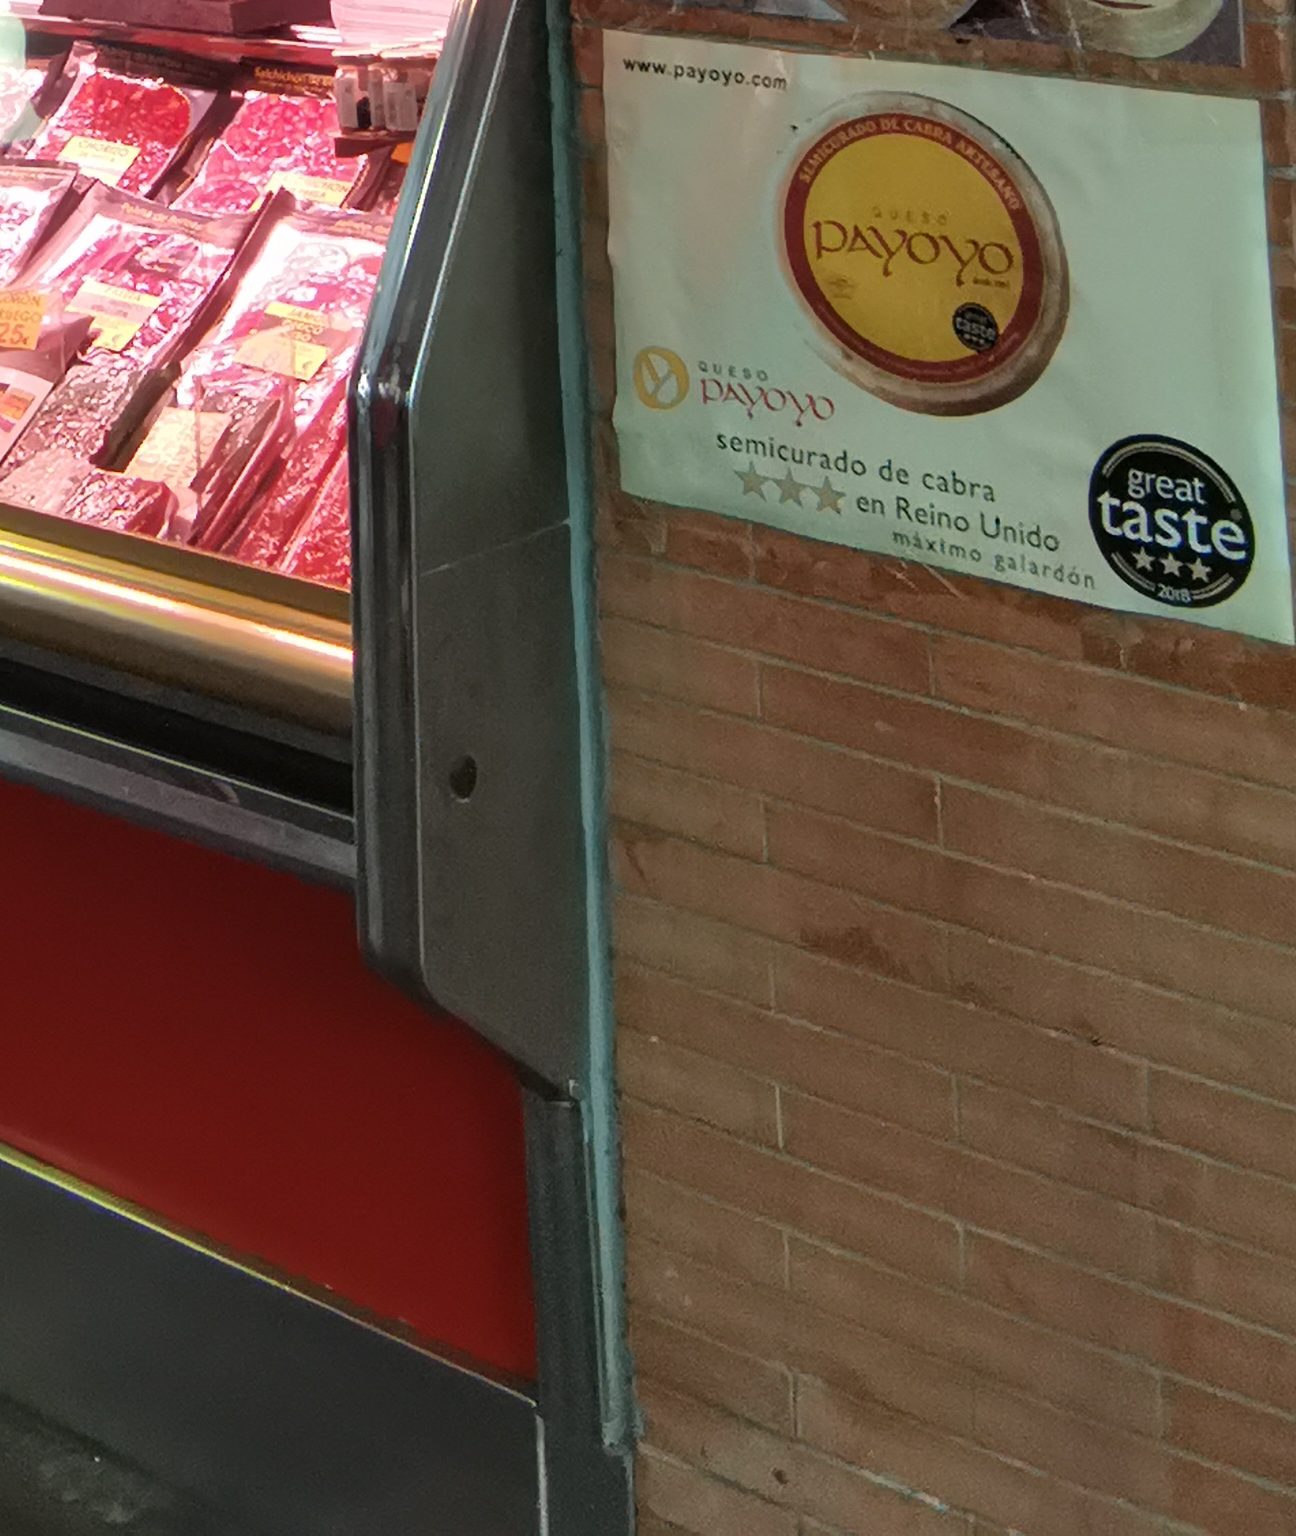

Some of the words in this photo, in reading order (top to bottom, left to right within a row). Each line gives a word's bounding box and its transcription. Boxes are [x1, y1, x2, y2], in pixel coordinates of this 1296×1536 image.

[622, 56, 788, 91] www.payoyo.com
[879, 117, 900, 131] DE
[903, 118, 953, 146] CABRA
[872, 205, 948, 227] QUESO
[811, 219, 1014, 289] PAYOYO
[698, 361, 769, 382] QUESO
[699, 378, 836, 428] PAYOYO
[716, 431, 867, 478] semicurado
[878, 459, 910, 486] de
[922, 468, 996, 503] cabra
[1126, 467, 1207, 506] great
[856, 491, 885, 514] en
[895, 493, 970, 534] Reino
[980, 512, 1060, 553] Unido
[1096, 489, 1249, 561] taste
[892, 529, 982, 564] máximo
[994, 549, 1096, 592] galardón
